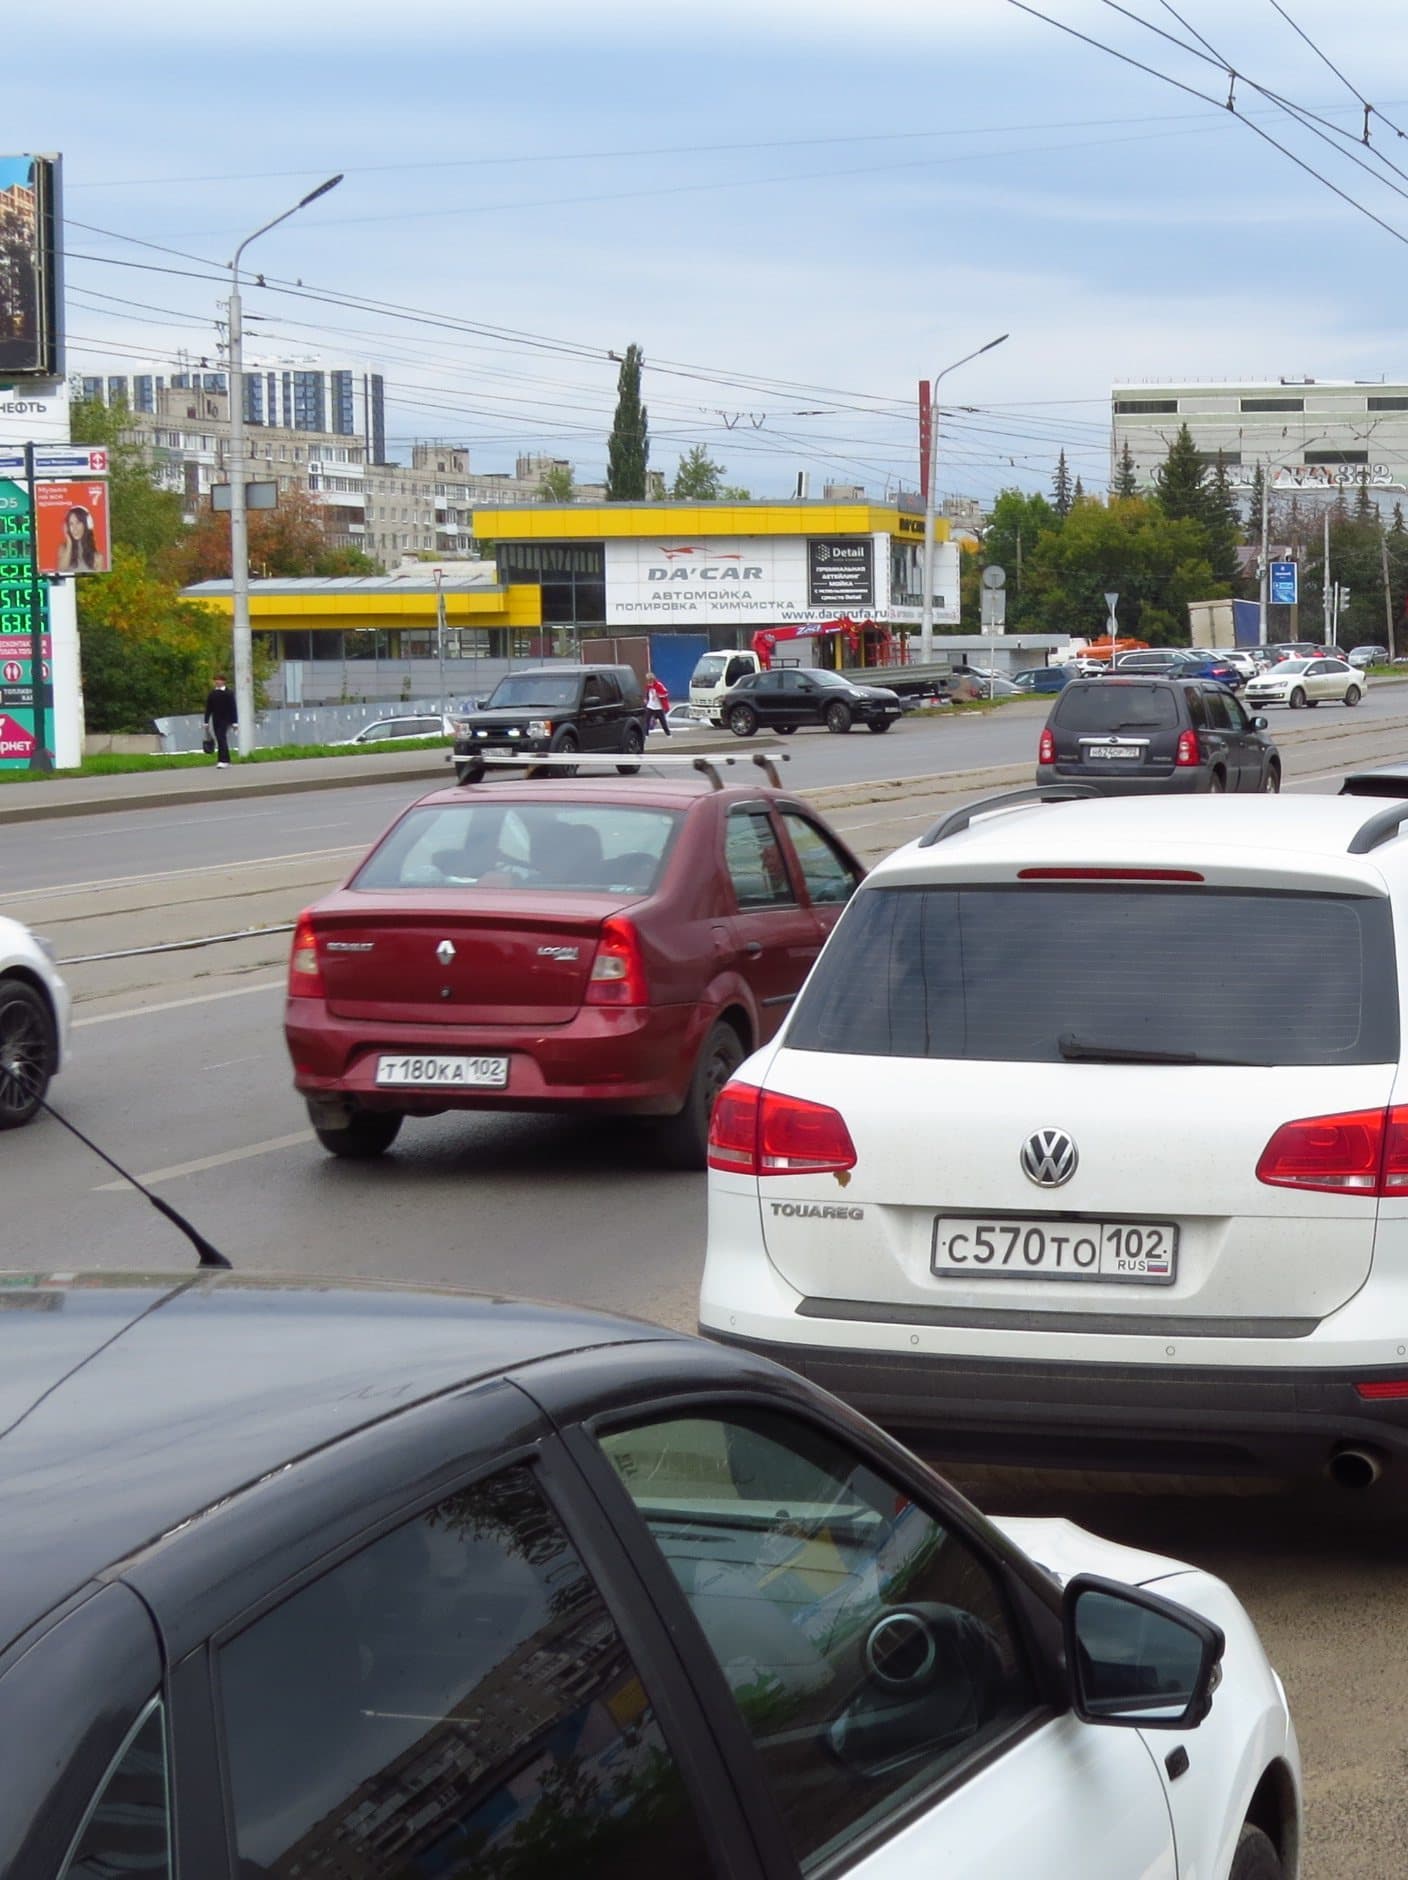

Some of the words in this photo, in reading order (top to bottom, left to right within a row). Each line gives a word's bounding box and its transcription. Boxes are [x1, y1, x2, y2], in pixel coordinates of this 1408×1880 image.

[832, 547, 864, 557] Detail
[648, 567, 762, 581] DA'CAR
[652, 589, 752, 600] АВТОМОЙКА
[615, 602, 697, 611] ПОЛИРОВКА
[711, 601, 795, 610] ХИМЧИСТКА
[471, 1059, 500, 1076] 102
[771, 1203, 864, 1220] TOUAREG
[948, 1226, 1096, 1267] С570ТО
[1106, 1228, 1162, 1259] 102
[1117, 1259, 1146, 1271] RUS
